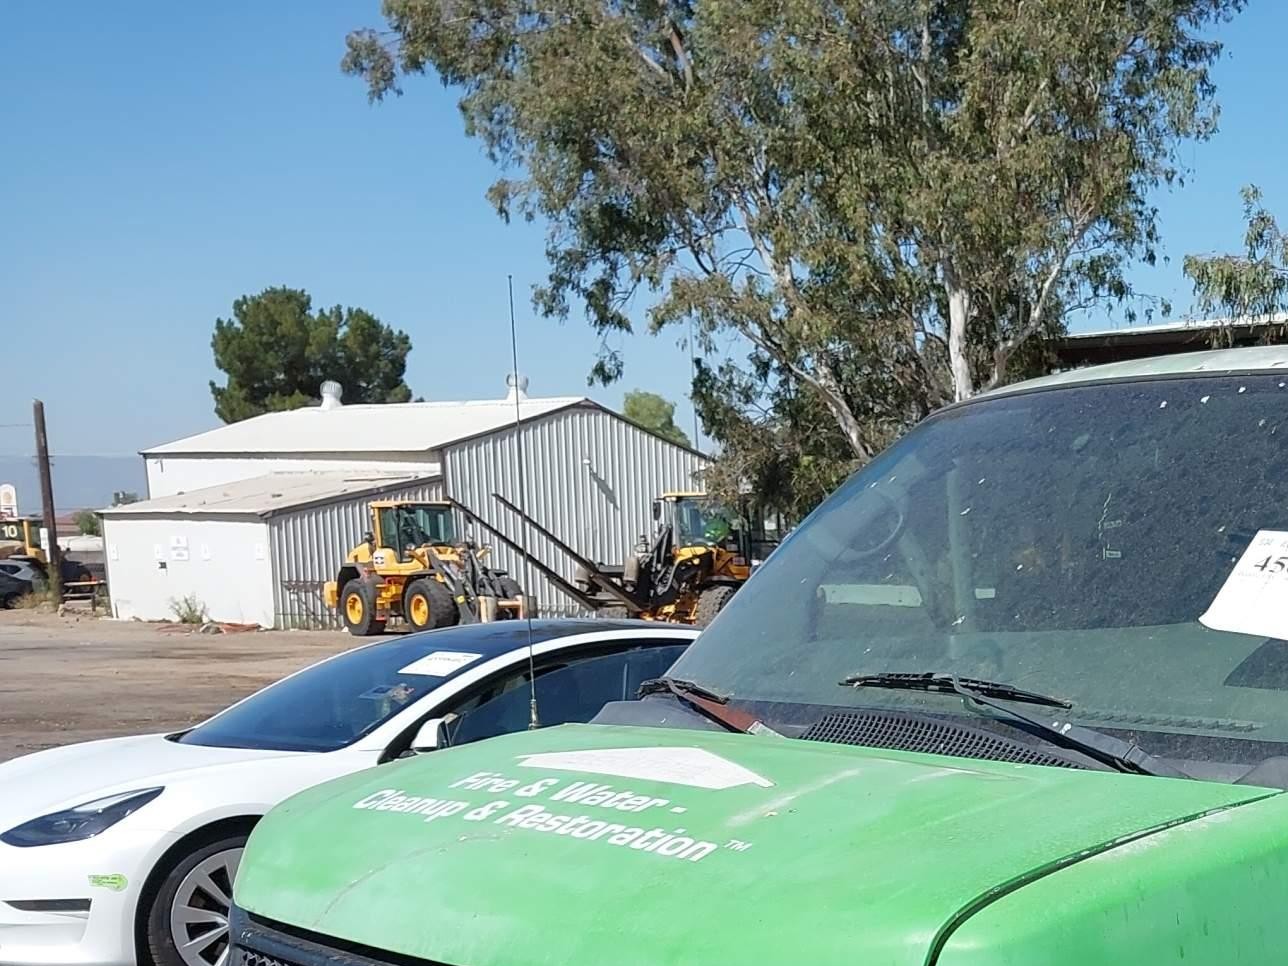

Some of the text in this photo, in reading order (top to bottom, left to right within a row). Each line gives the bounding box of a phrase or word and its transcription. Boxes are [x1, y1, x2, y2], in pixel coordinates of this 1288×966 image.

[2, 525, 17, 538] 10
[352, 789, 470, 822] Cleanup
[463, 800, 510, 821] &
[448, 771, 520, 793] Fire
[514, 778, 559, 797] &
[549, 782, 670, 812] Water
